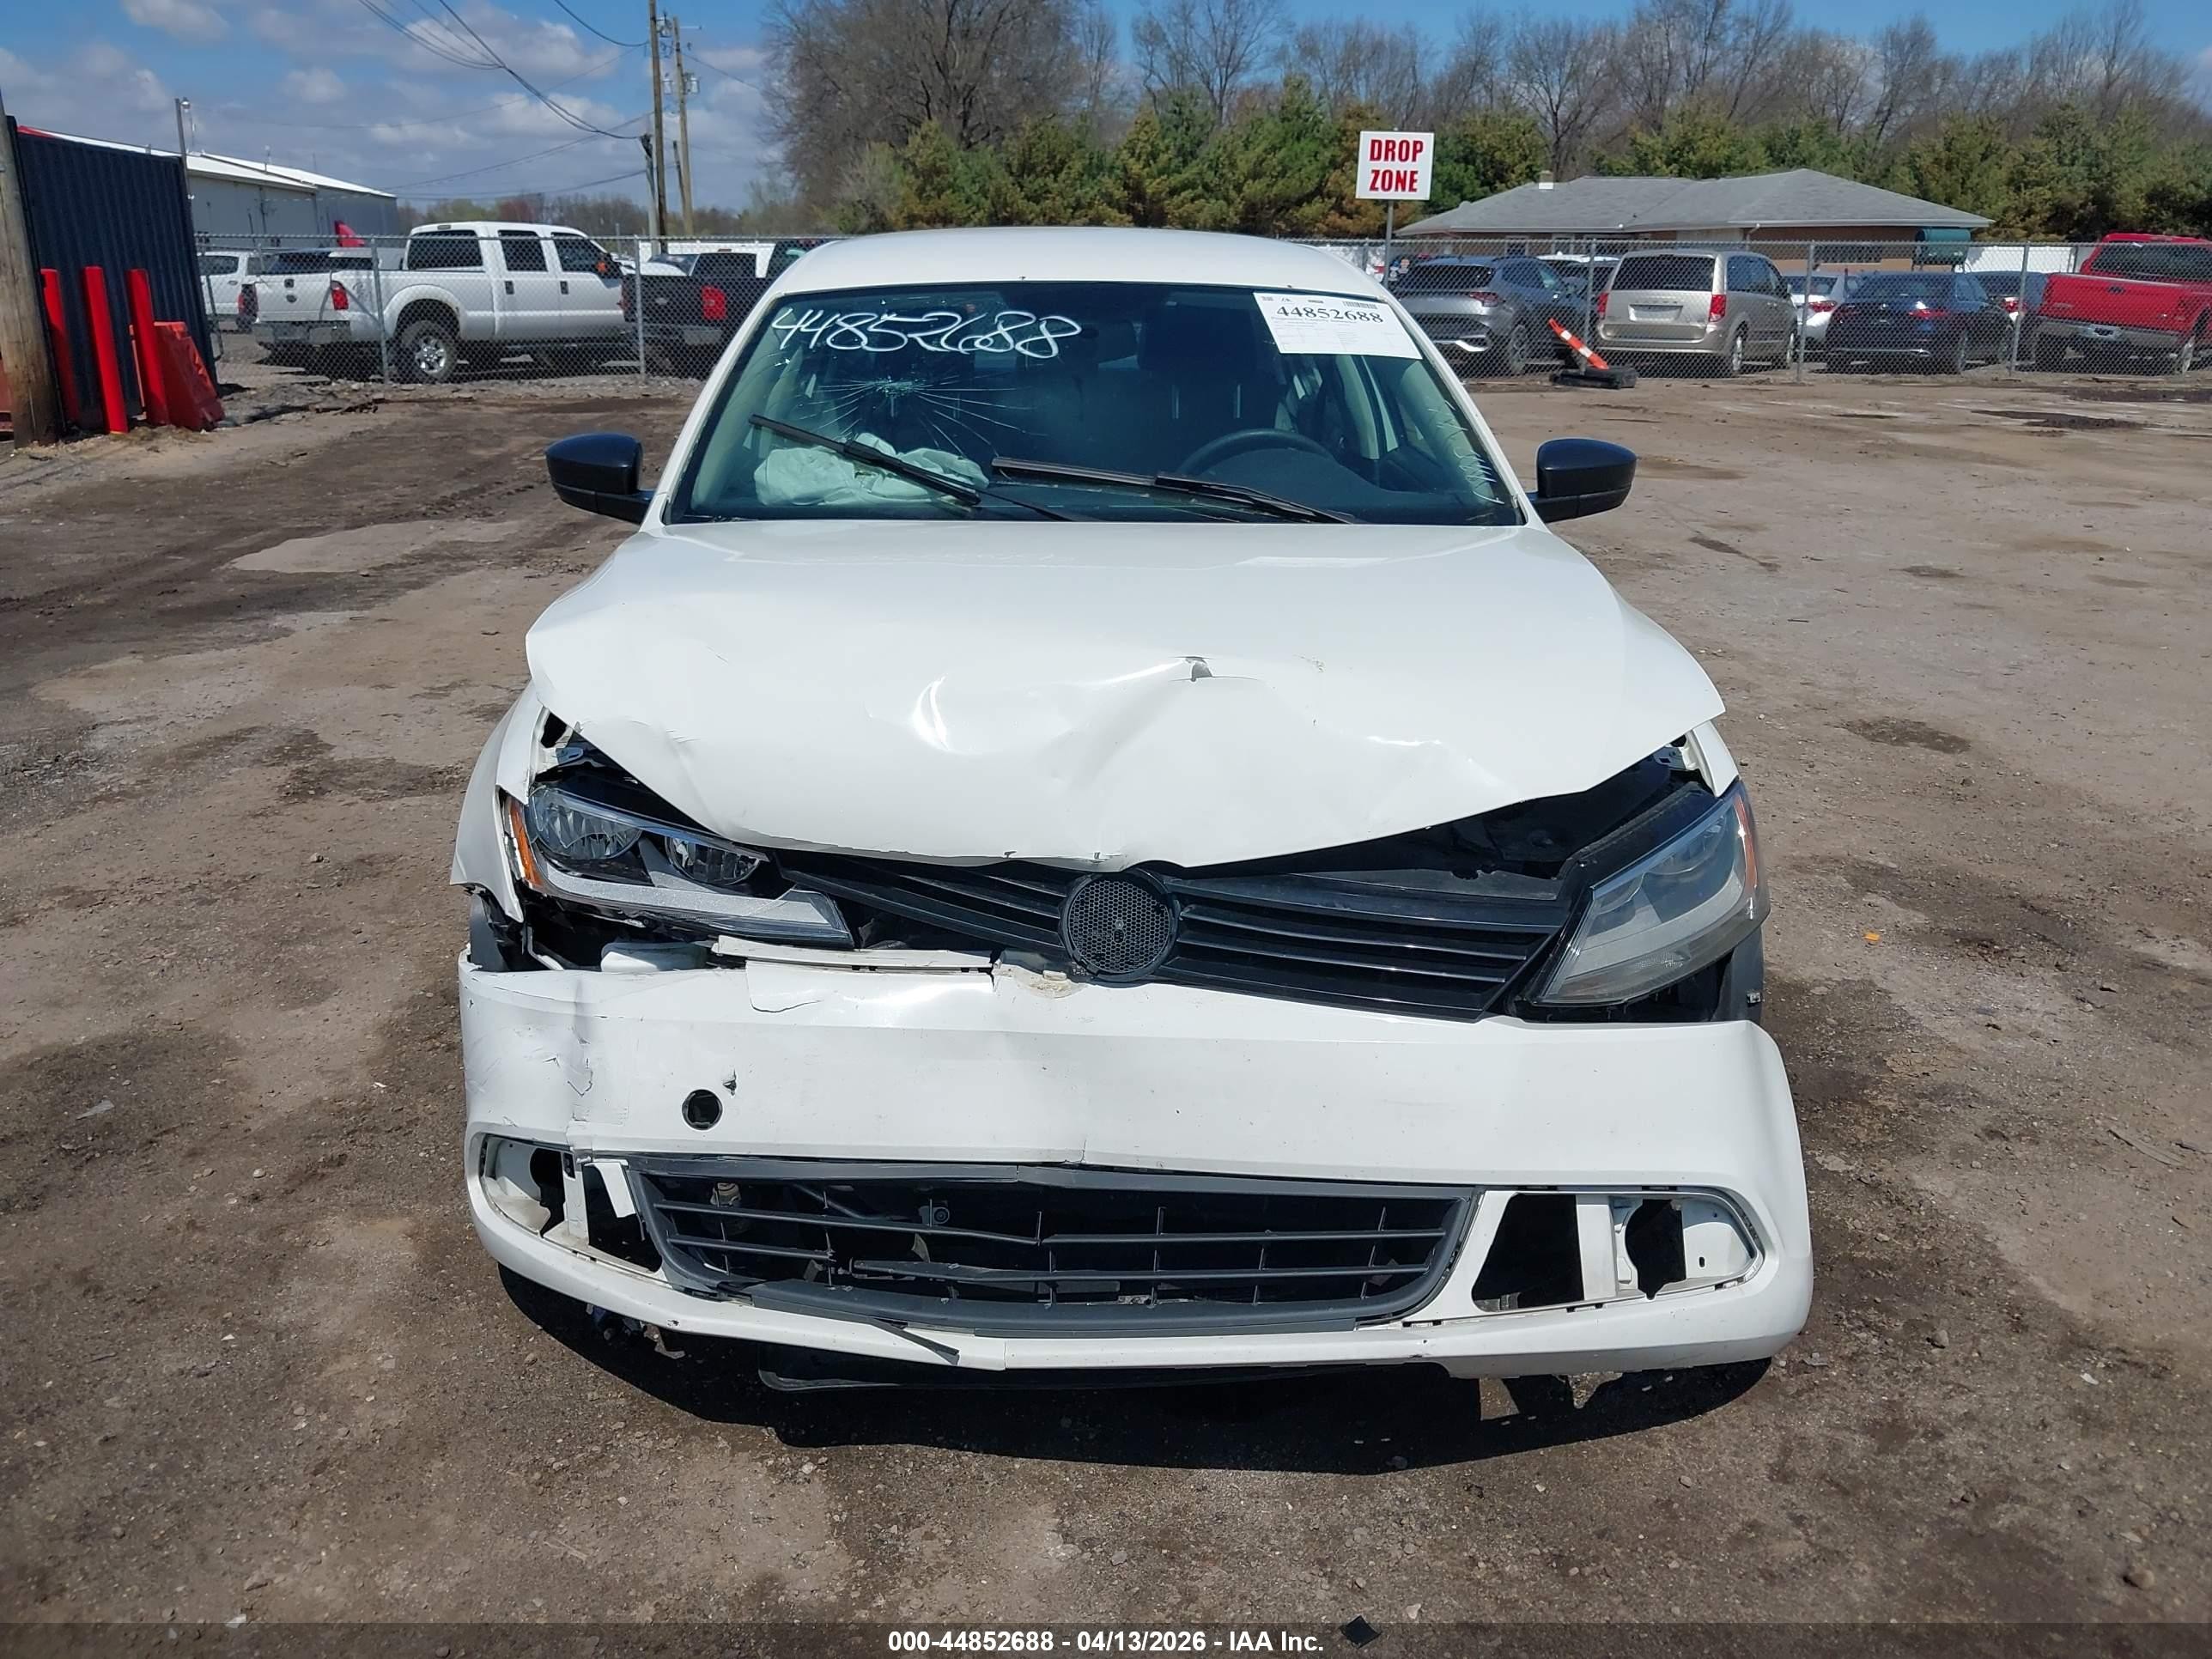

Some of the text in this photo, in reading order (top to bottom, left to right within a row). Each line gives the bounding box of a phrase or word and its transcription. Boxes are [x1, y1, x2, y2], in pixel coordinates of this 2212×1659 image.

[1369, 138, 1423, 162] DROP
[1369, 169, 1419, 192] ZONE
[1276, 306, 1384, 324] 44852688
[771, 307, 1082, 359] 44852688
